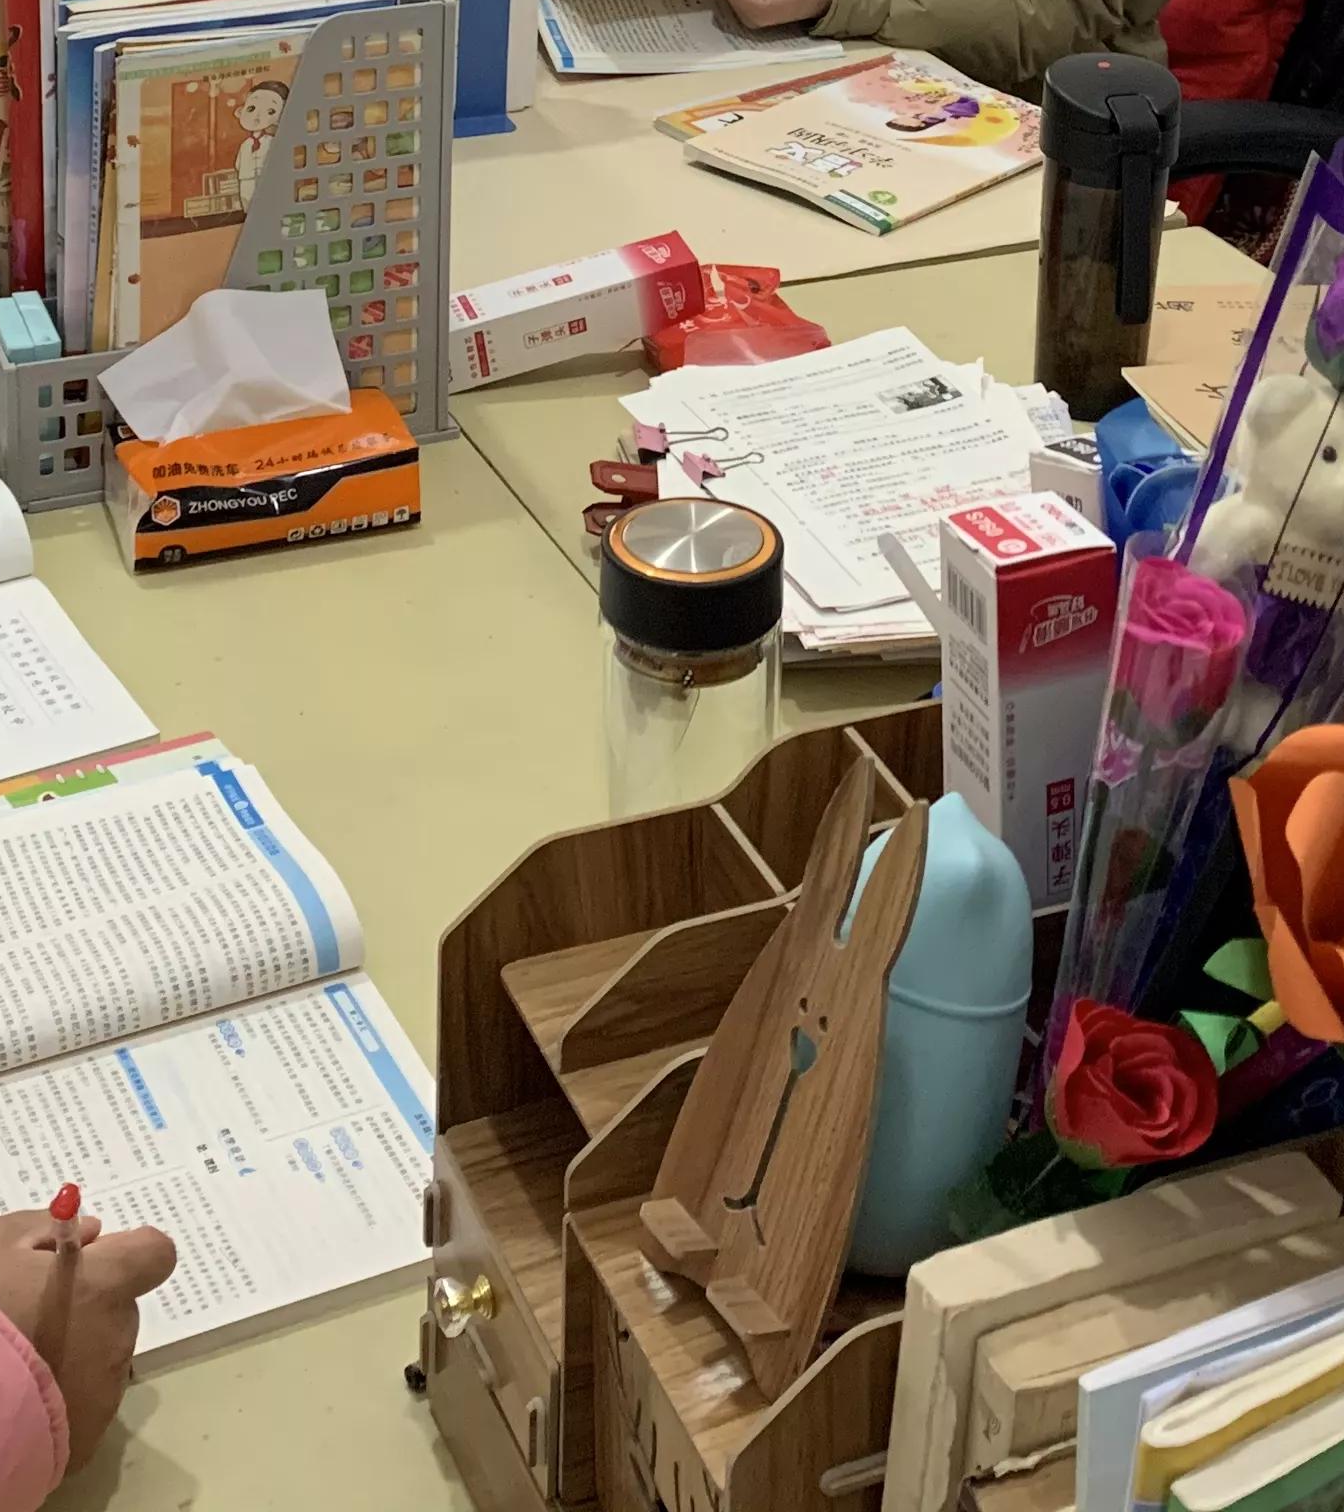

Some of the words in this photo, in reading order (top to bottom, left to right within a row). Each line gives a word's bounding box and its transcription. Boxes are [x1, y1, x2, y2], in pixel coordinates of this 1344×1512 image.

[152, 462, 240, 479] 加油免费洗车
[188, 494, 268, 514] ZHONGYOU
